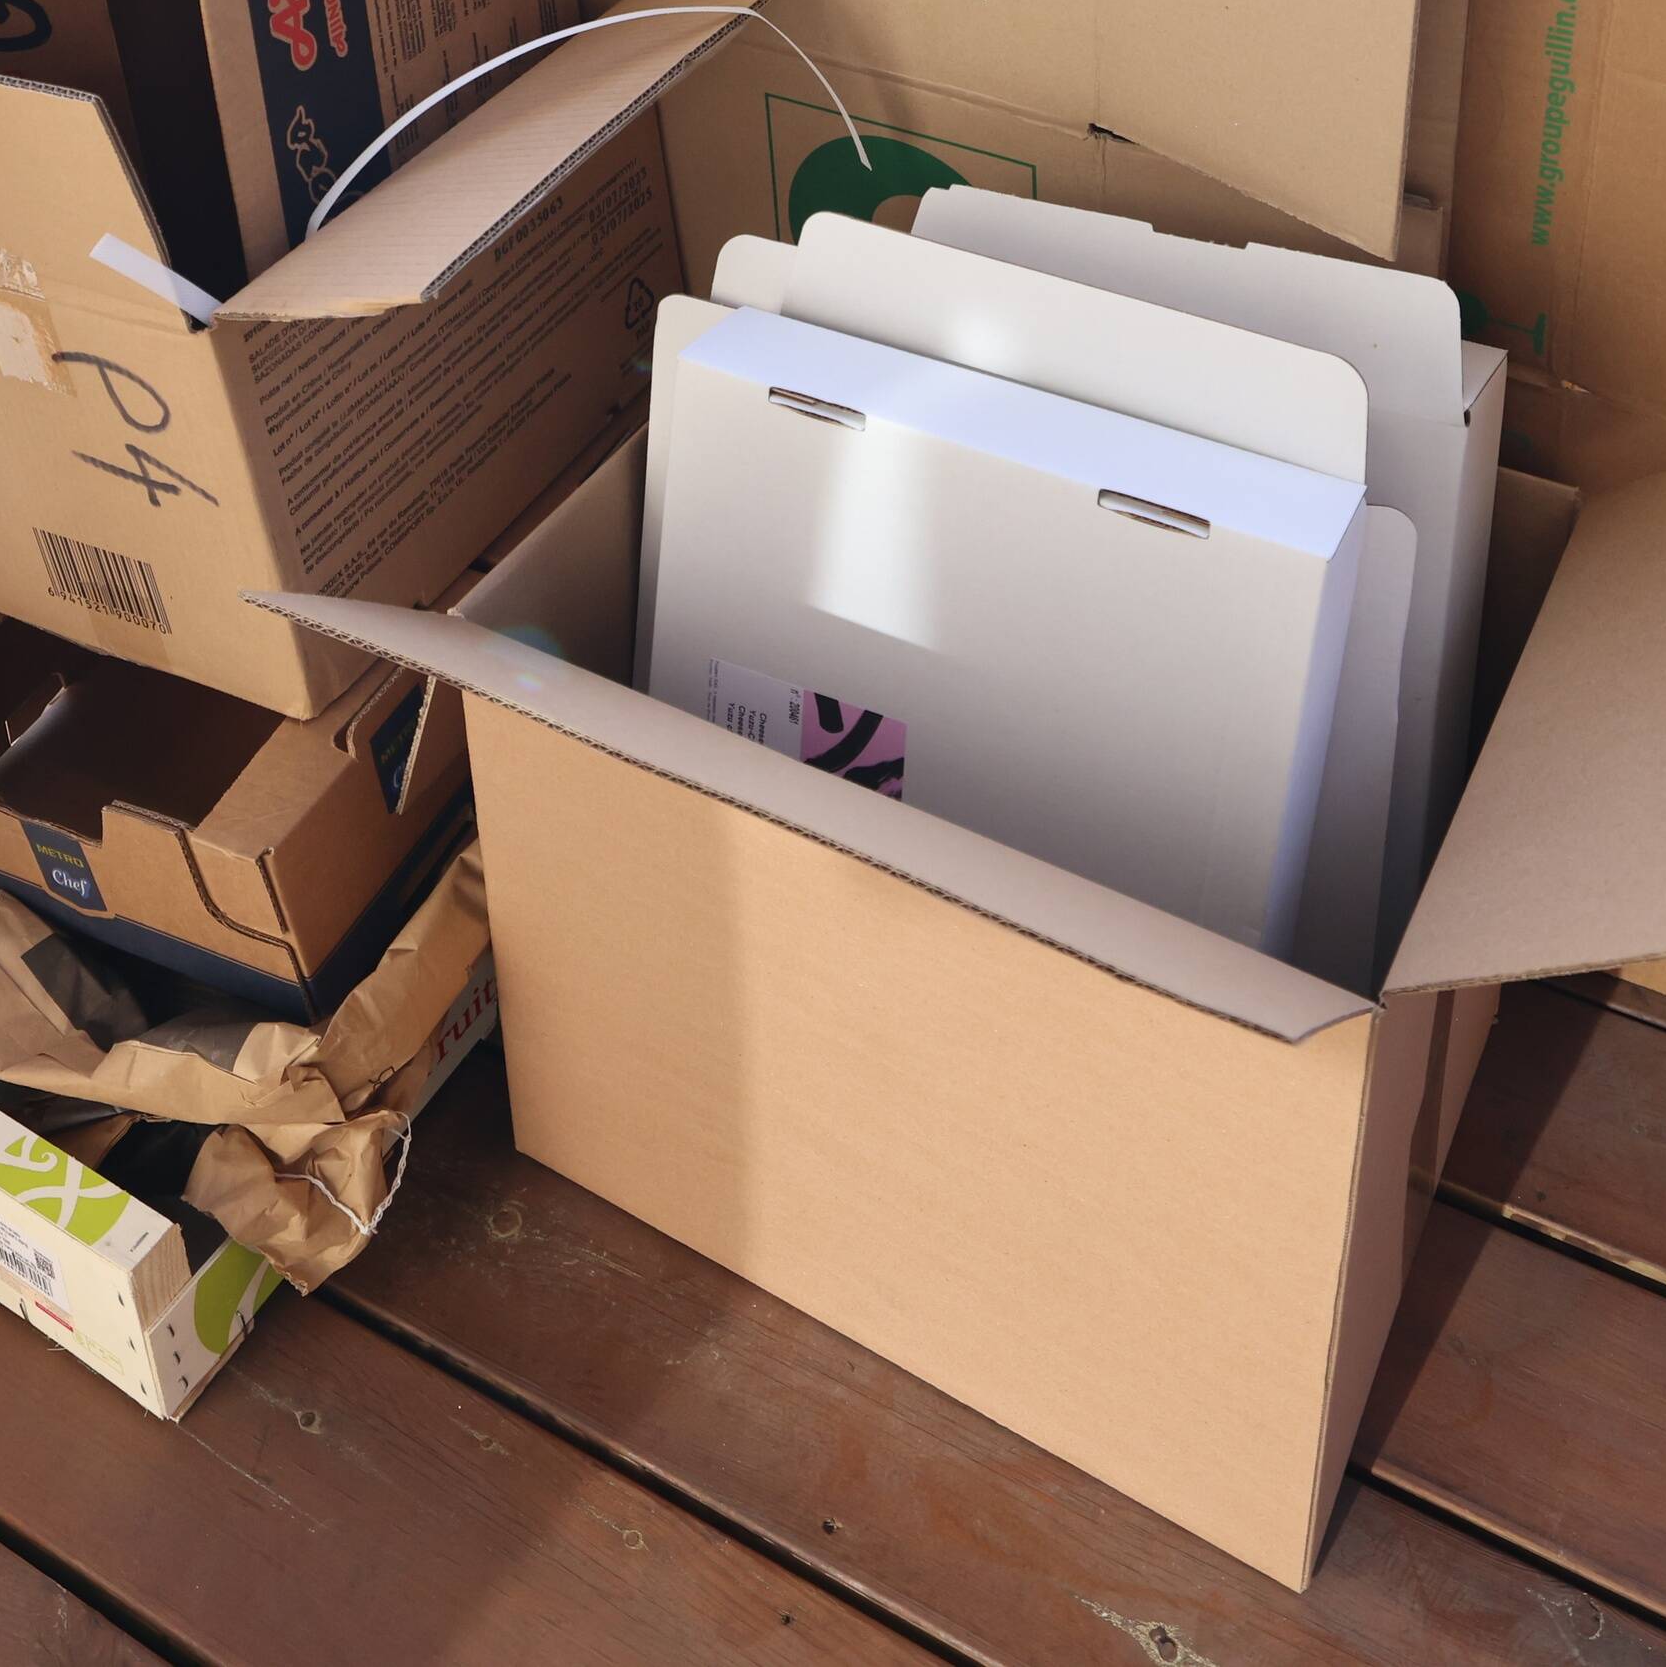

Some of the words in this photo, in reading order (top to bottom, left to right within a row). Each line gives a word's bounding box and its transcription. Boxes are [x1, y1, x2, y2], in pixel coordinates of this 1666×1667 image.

[247, 331, 281, 365] SALADE
[279, 371, 293, 389] net
[264, 397, 291, 428] Produit
[290, 388, 302, 406] en
[272, 439, 285, 458] Lot
[298, 416, 311, 435] Lot
[300, 494, 334, 531] conserver
[47, 587, 55, 598] 6
[59, 590, 110, 616] 941521
[115, 608, 167, 635] 900070
[747, 710, 757, 740] Yuzu-C
[758, 712, 767, 745] Cheese
[35, 842, 85, 869] METRO
[51, 868, 89, 897] Chef
[435, 977, 495, 1065] ruit
